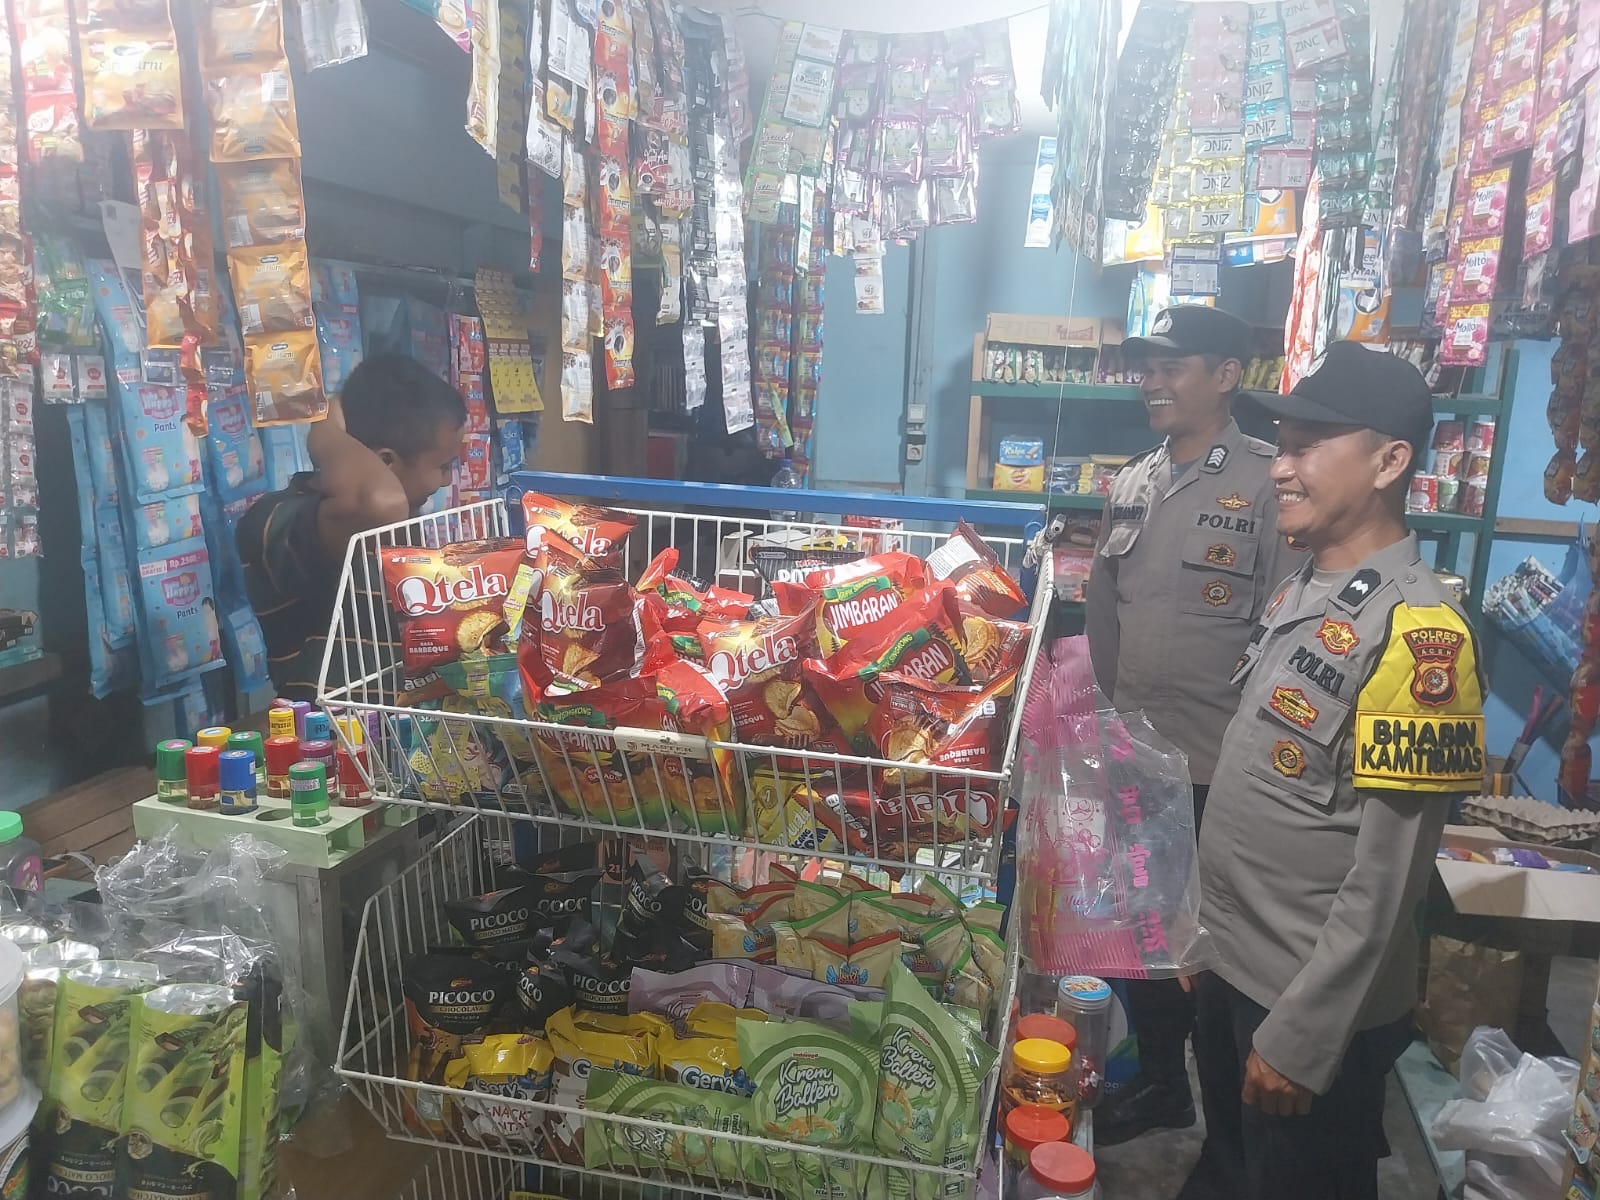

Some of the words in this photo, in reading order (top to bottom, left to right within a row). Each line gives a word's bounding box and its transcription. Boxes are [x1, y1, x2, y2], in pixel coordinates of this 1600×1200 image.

[1295, 34, 1321, 53] ZINC
[1247, 118, 1278, 136] ZINC
[1203, 140, 1232, 152] ZINC
[1202, 176, 1231, 190] ZINC
[1201, 213, 1230, 227] ZINC
[1465, 255, 1488, 268] Molto
[1455, 321, 1477, 334] Molto
[154, 422, 177, 433] Pants
[1196, 512, 1256, 535] POLRI
[396, 564, 509, 617] Qtela
[176, 605, 199, 619] Pants
[541, 588, 606, 633] Qtela
[829, 592, 899, 633] JIMBARAN
[1410, 630, 1458, 642] POLRES
[408, 645, 450, 655] BARBEQUE
[707, 632, 799, 692] Qtela
[1288, 644, 1346, 698] POLRI
[1372, 718, 1477, 747] BHABIN
[939, 747, 986, 762] BARBEQUE
[1360, 742, 1482, 775] KAMTIBMAS
[608, 863, 622, 874] 21
[470, 907, 530, 931] PICOCO
[572, 973, 633, 993] PICOCO
[428, 988, 497, 1005] PICOCO
[891, 1027, 937, 1071] Krem
[778, 1059, 834, 1086] Krem
[880, 1044, 937, 1090] Ballen
[681, 1065, 735, 1094] Gery
[774, 1080, 840, 1115] Ballen
